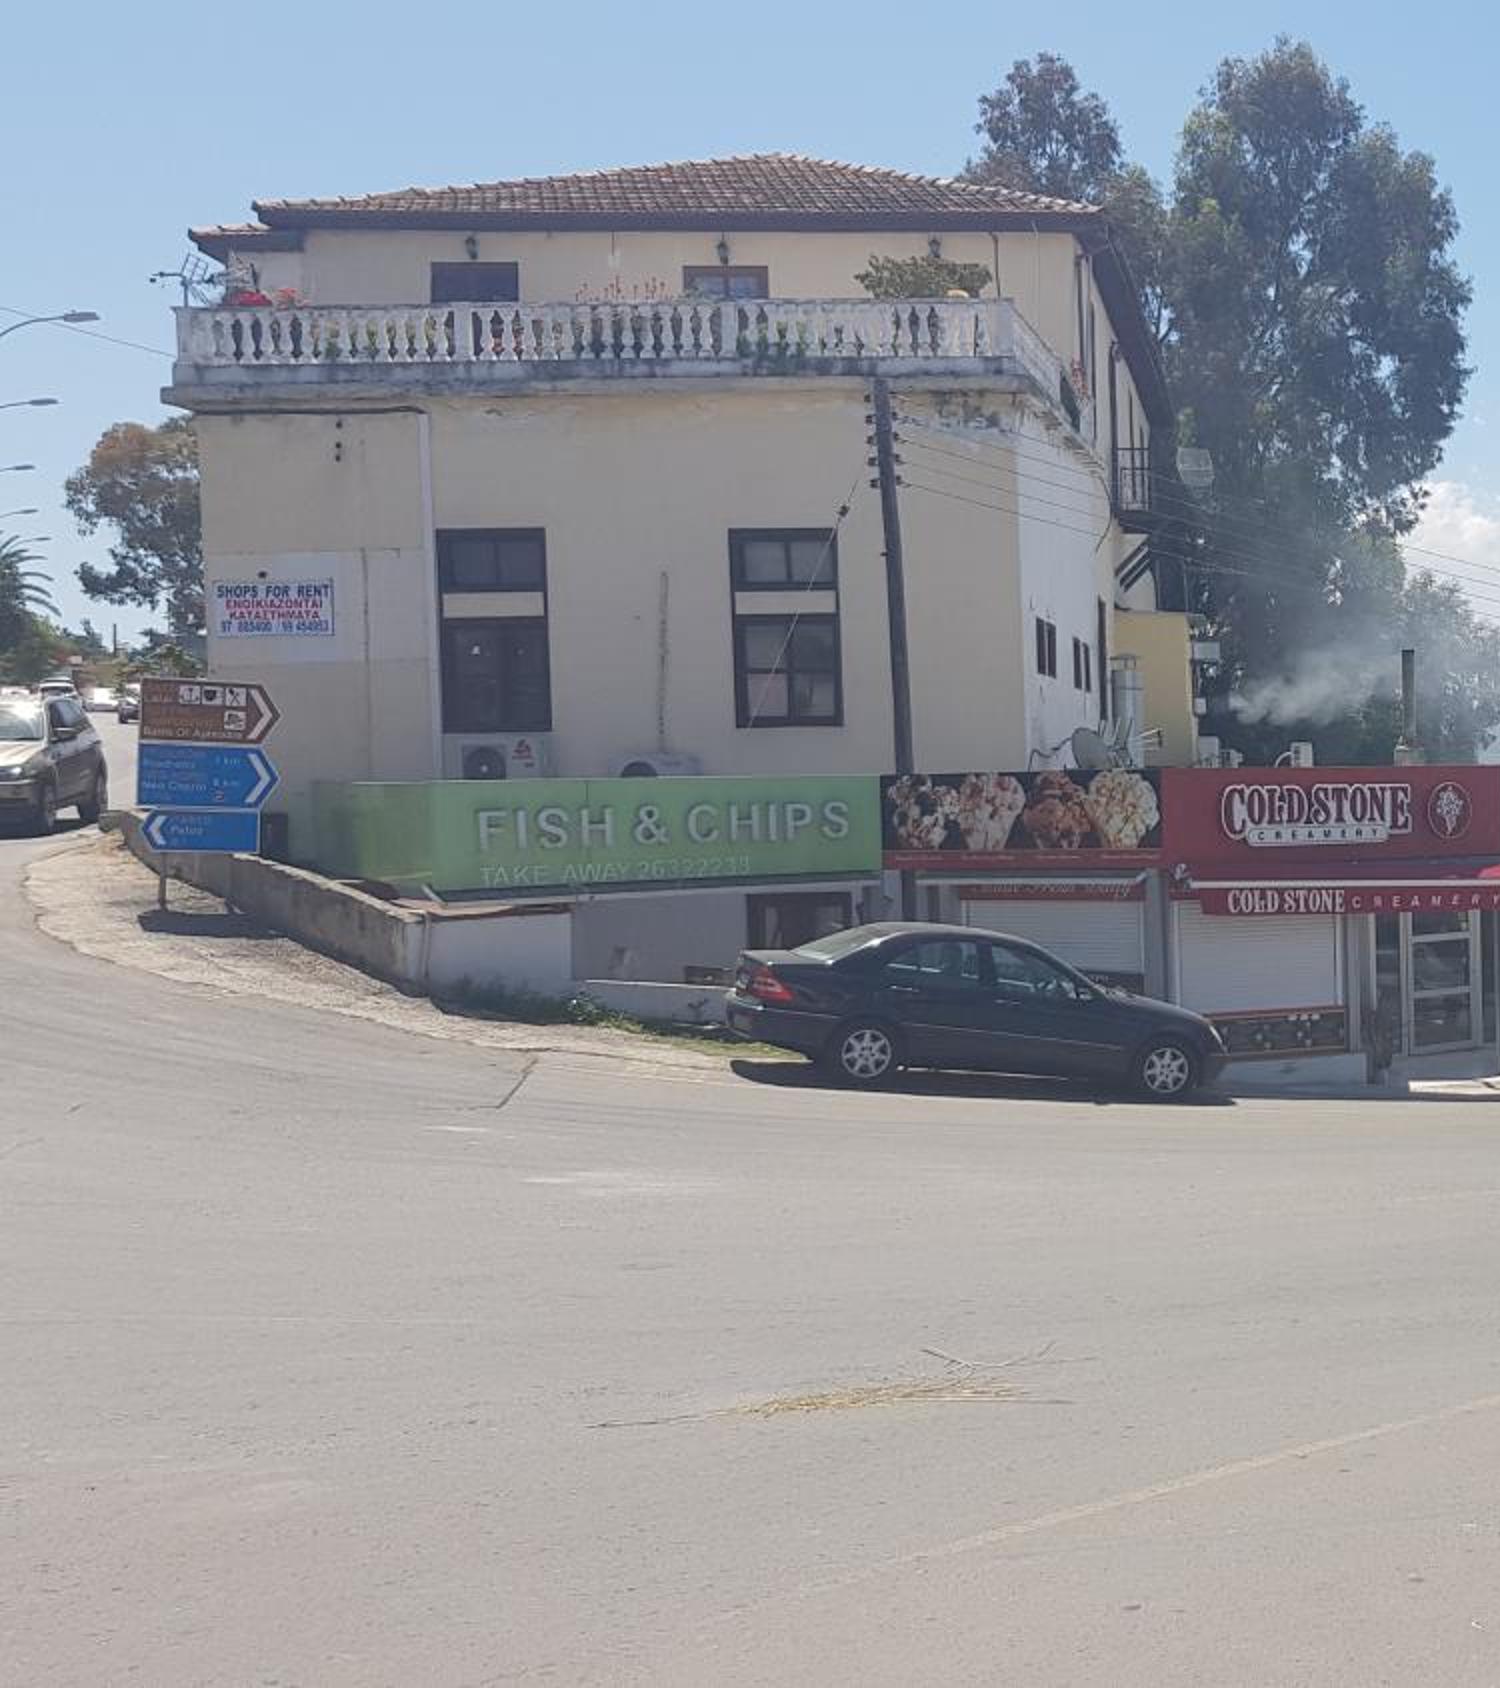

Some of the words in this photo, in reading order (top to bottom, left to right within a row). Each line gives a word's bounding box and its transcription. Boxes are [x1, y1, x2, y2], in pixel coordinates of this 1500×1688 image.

[217, 585, 258, 598] SHOPS
[265, 585, 290, 598] FOR
[298, 584, 329, 598] RENT
[1222, 784, 1309, 840] COLD
[1311, 784, 1413, 834] STONE
[477, 807, 615, 850] FISH
[634, 804, 669, 845] &
[687, 800, 850, 843] CHIPS
[1257, 828, 1379, 841] CREAMERY
[480, 864, 549, 887] TAKE
[562, 860, 630, 882] AWAY
[1227, 889, 1279, 913] COLD
[1283, 889, 1345, 913] STONE
[1352, 893, 1500, 909] CREAMERY
